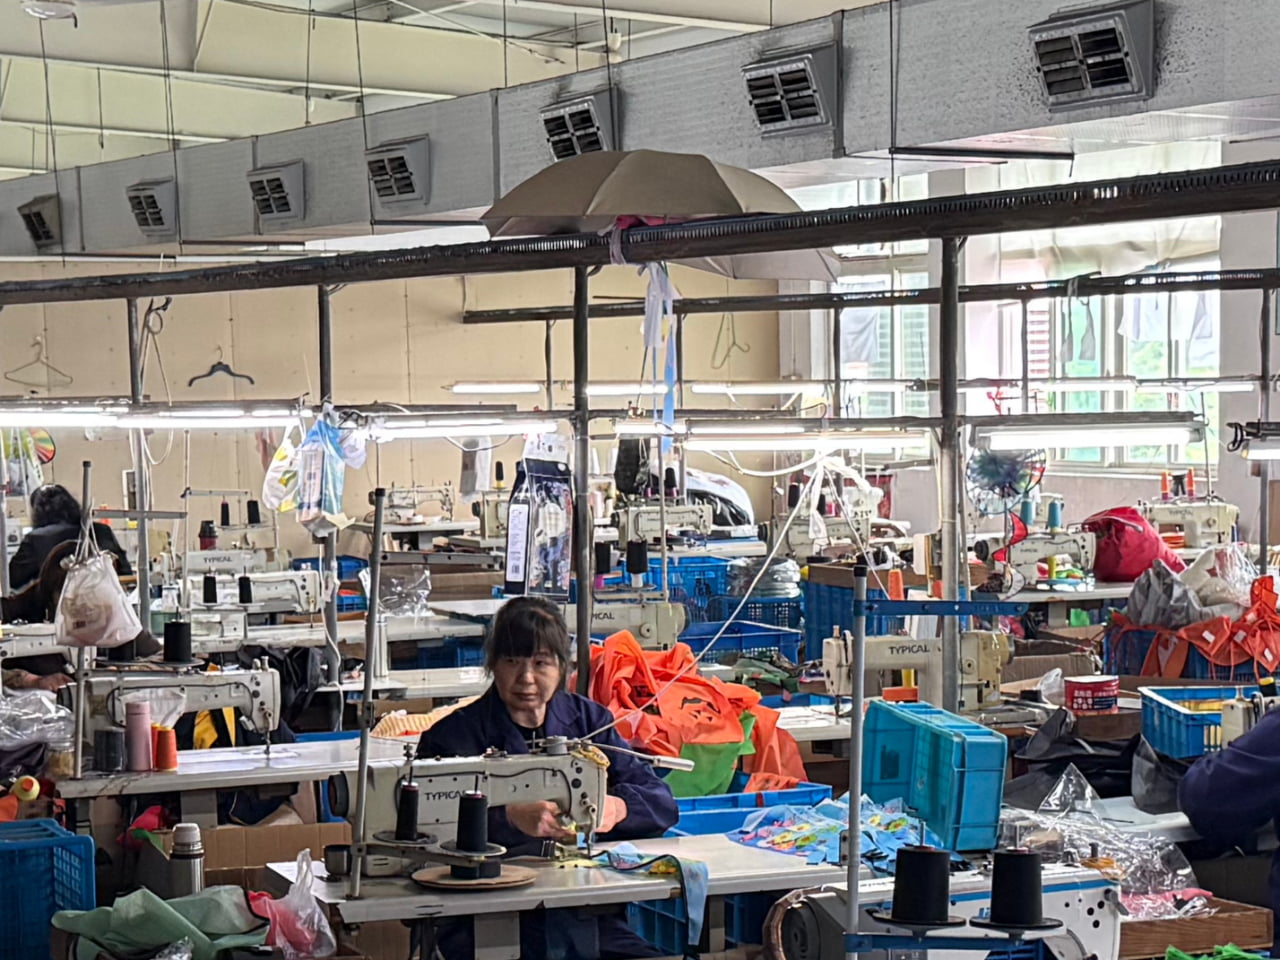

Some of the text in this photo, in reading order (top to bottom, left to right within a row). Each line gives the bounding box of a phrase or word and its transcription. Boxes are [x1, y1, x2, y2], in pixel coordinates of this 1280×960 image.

[203, 556, 232, 564] TYPICAL
[888, 644, 930, 655] TYPICAL
[424, 789, 466, 801] TYPICA
